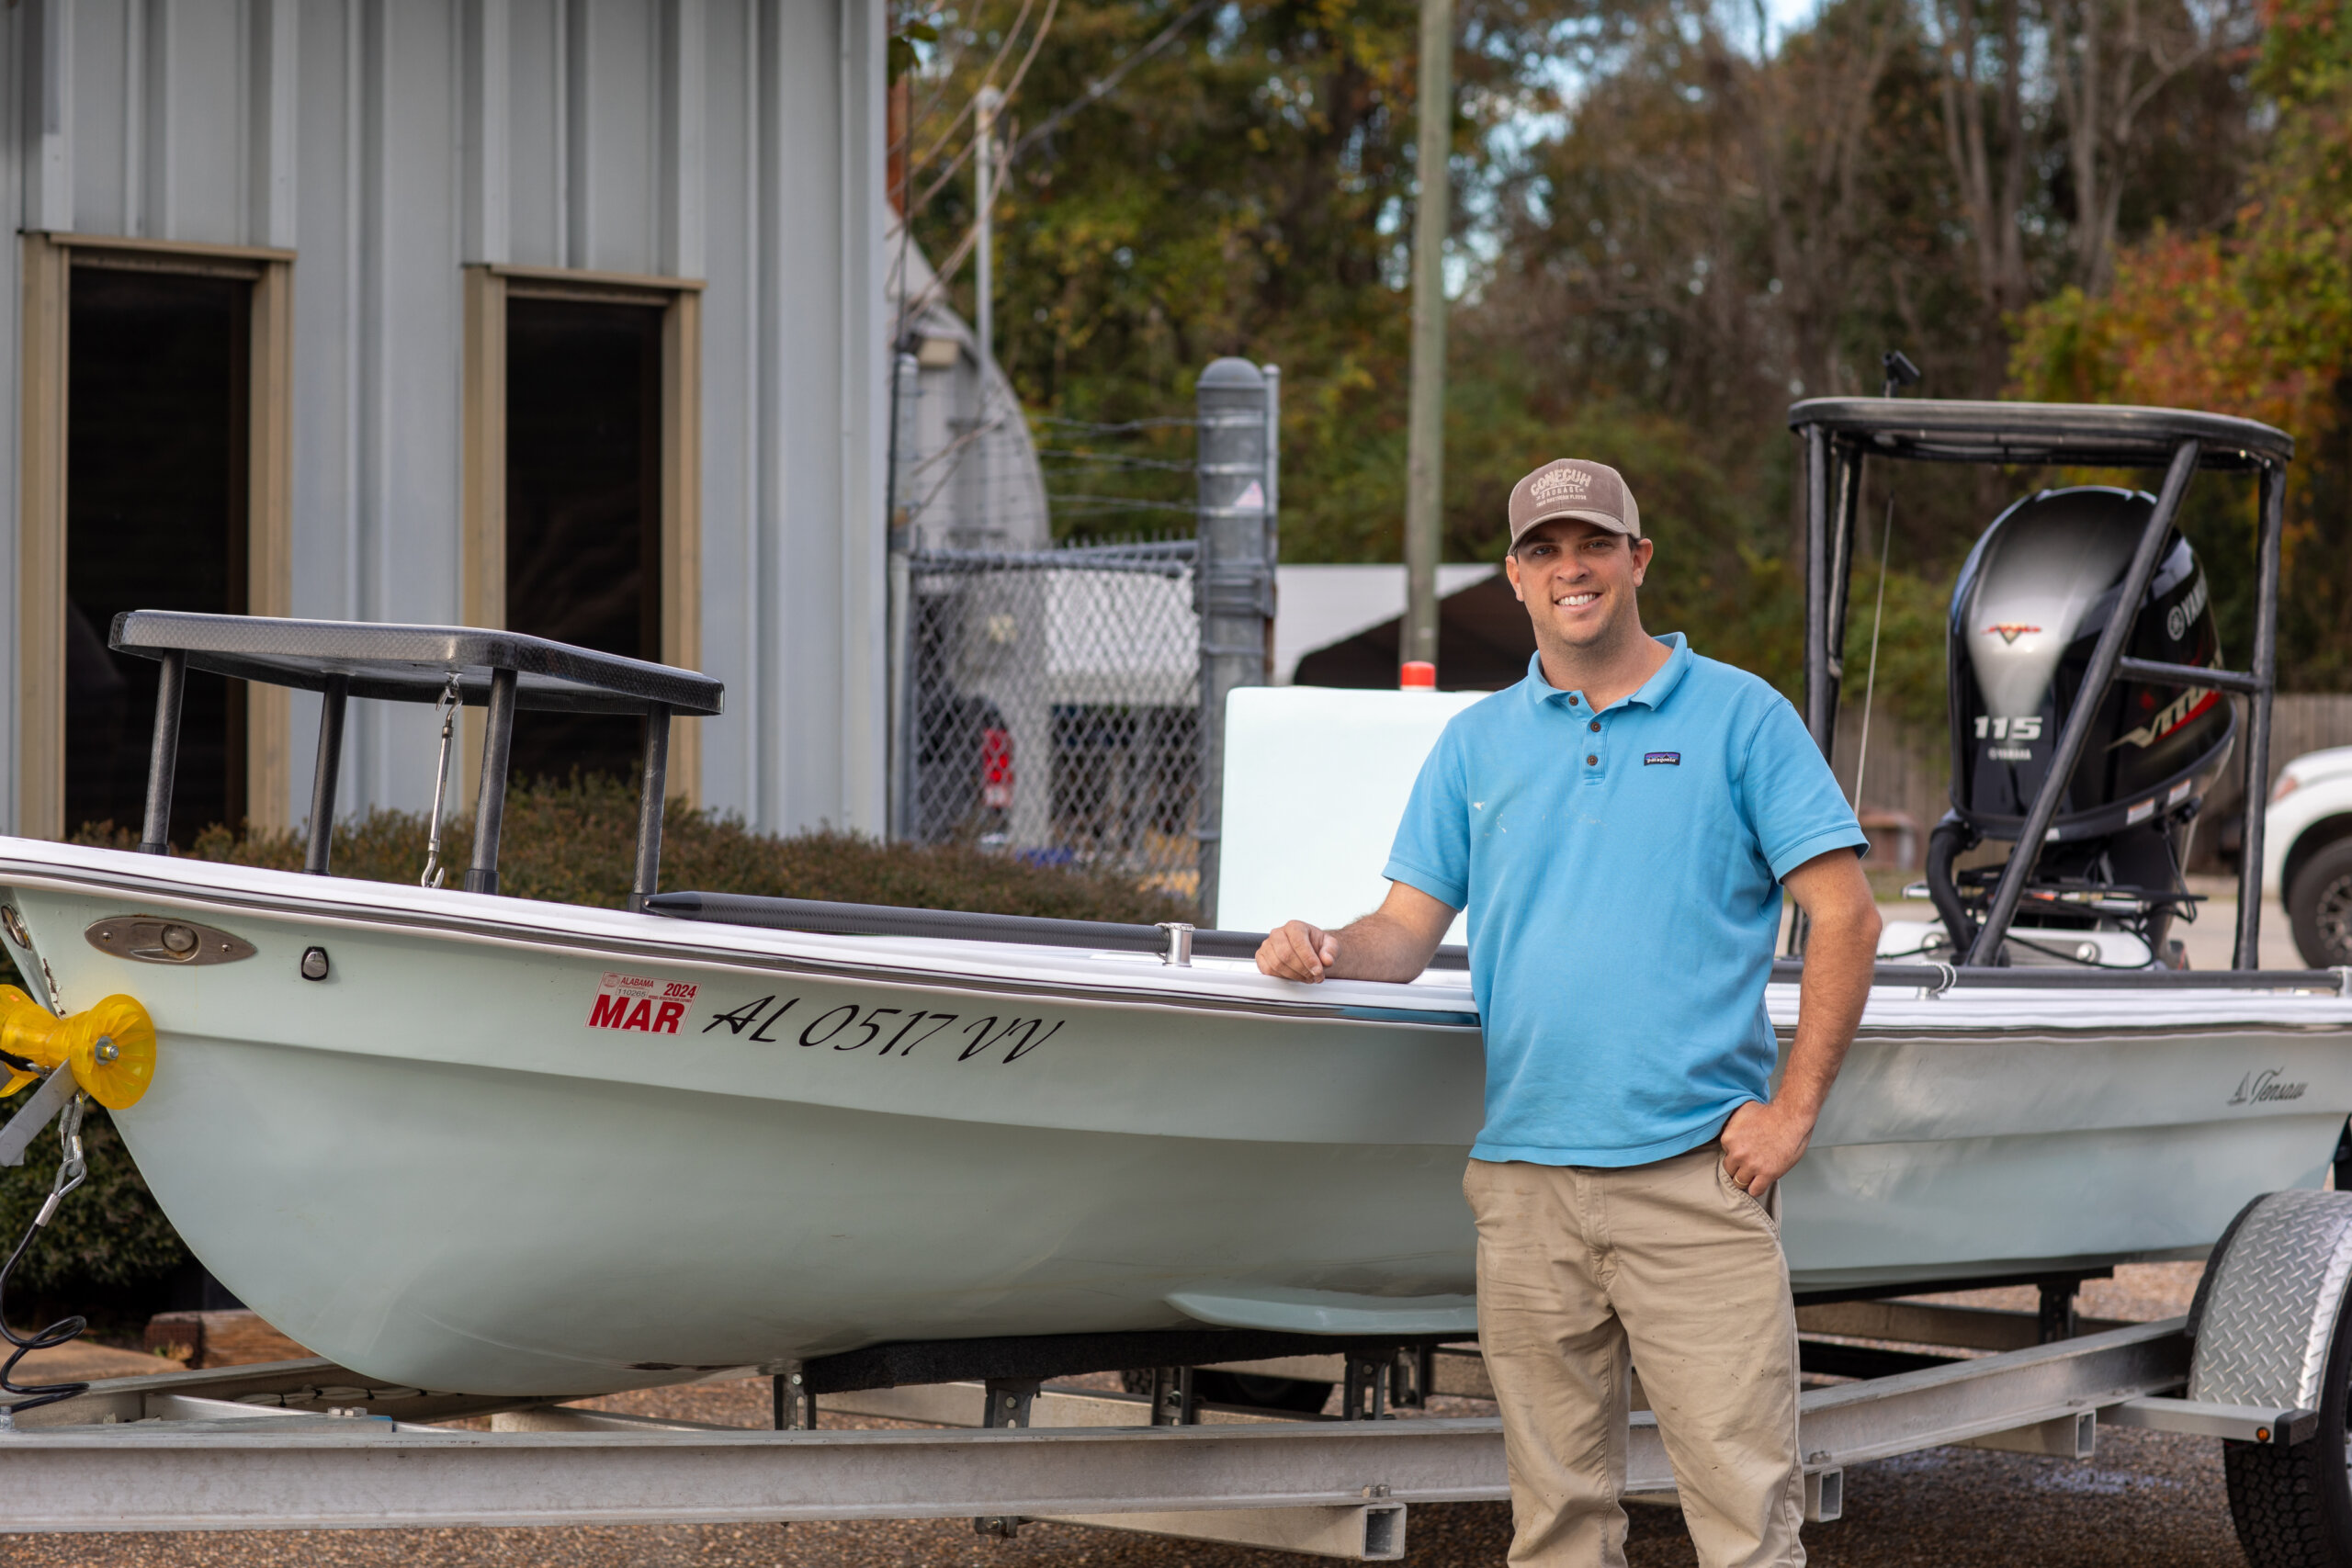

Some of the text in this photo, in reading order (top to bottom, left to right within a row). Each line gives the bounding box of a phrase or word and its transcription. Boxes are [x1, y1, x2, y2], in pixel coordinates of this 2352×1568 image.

[1531, 468, 1591, 496] CONECUH
[1974, 716, 2043, 740] 115
[1646, 755, 1676, 764] patagonia
[620, 976, 654, 988] ALABAMA
[663, 982, 697, 998] 2024
[589, 994, 685, 1034] MAR
[702, 995, 800, 1043] AL
[798, 1004, 959, 1056] 0517
[2249, 1066, 2309, 1106] Tensaw
